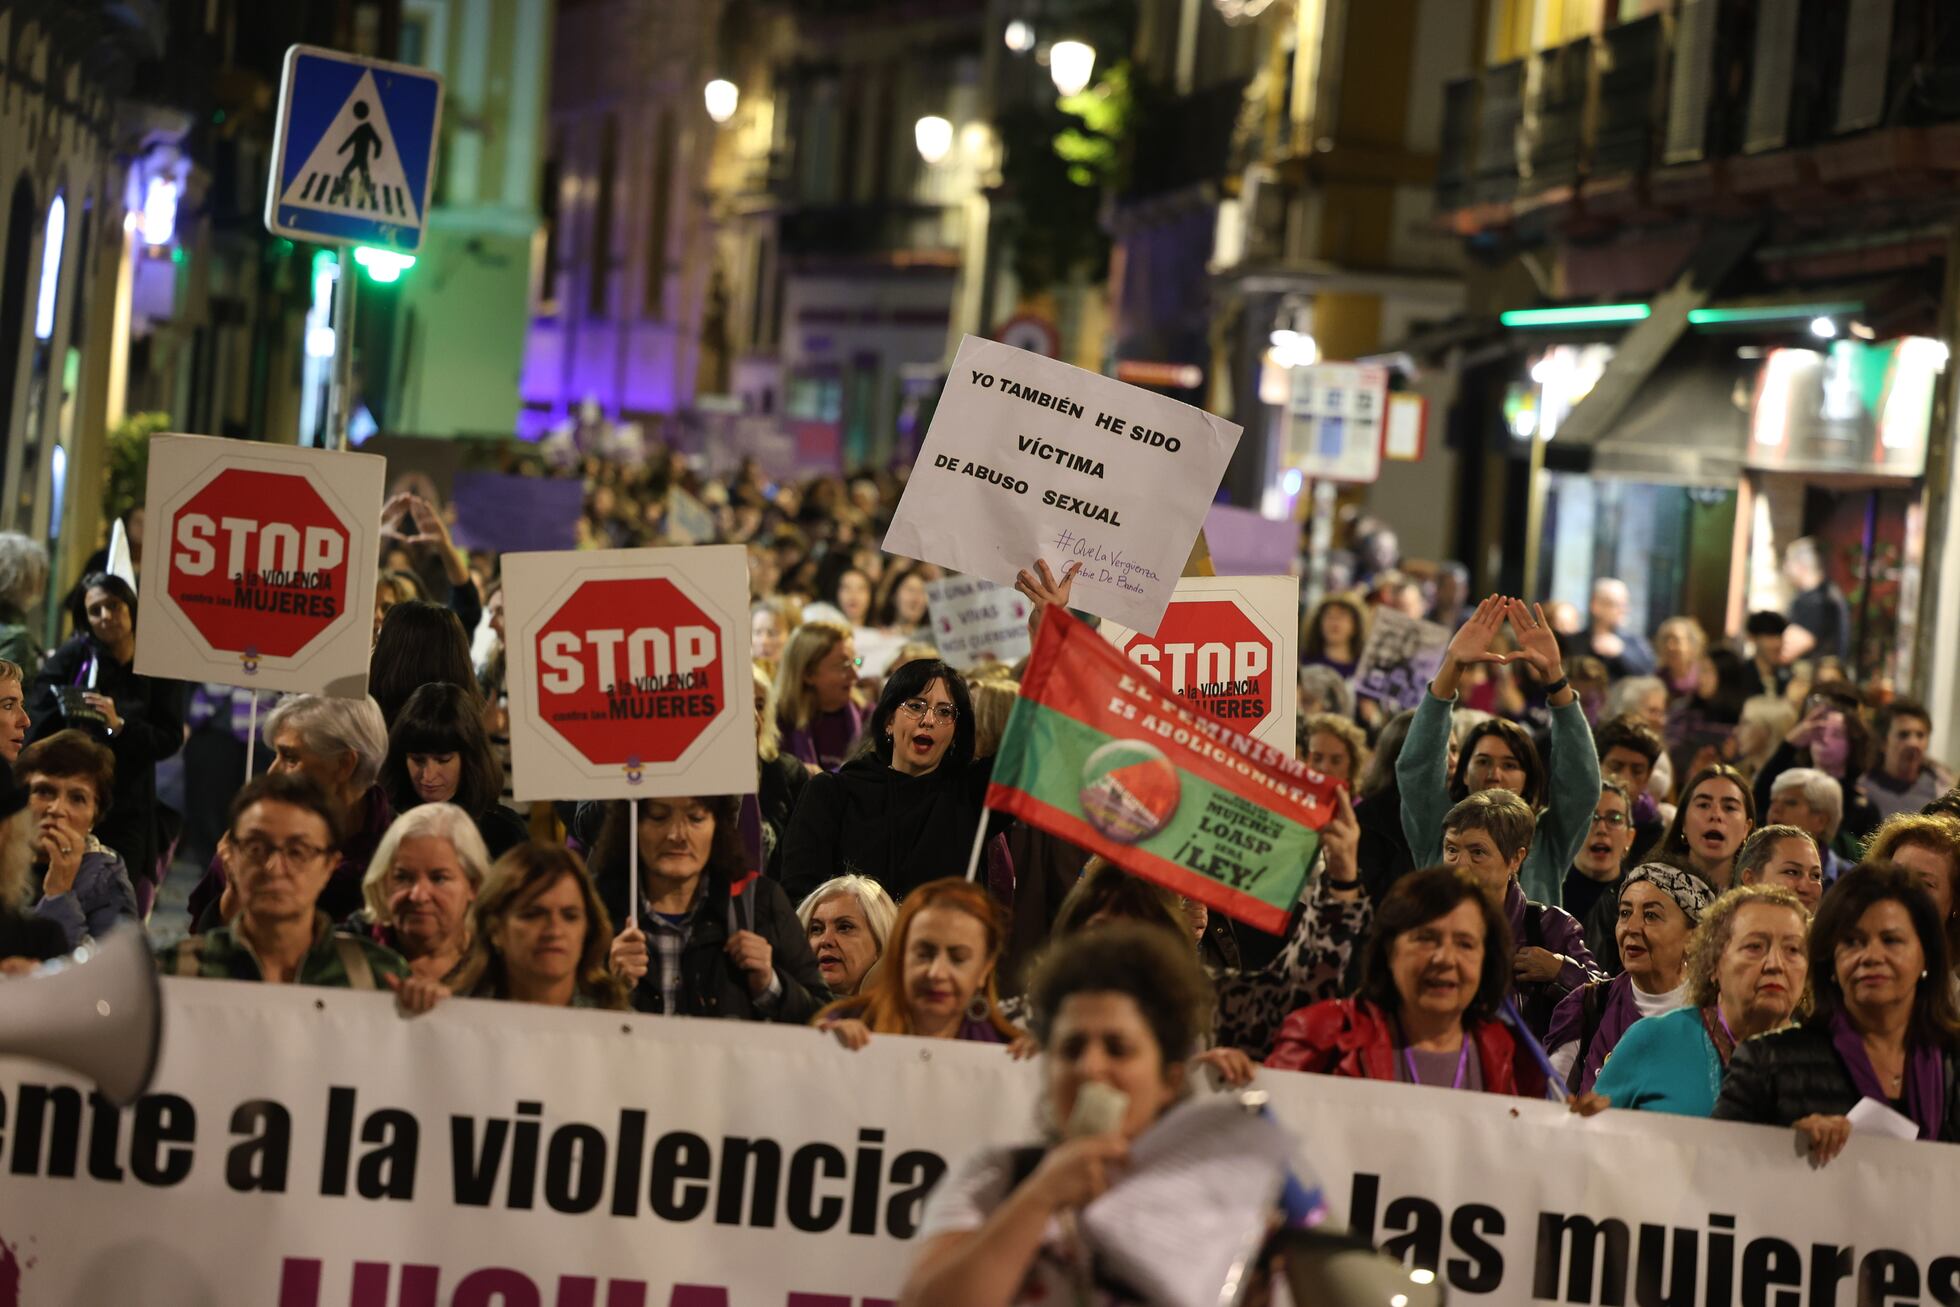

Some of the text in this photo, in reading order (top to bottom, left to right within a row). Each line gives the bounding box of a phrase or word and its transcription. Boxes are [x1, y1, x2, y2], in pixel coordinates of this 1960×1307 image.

[970, 370, 1182, 453] YO TAMBIÉN HE SIDO
[1017, 435, 1106, 479] VÍCTIMA
[934, 454, 1121, 527] DE ABUSO SEXUAL
[174, 512, 345, 580] STOP
[234, 569, 332, 590] a la VIOLENCIA
[1060, 559, 1095, 580] Cbie
[234, 586, 337, 618] MUJERES
[540, 625, 717, 694] STOP
[1128, 641, 1268, 695] STOP
[606, 671, 709, 698] a la VIOLENCIA
[1118, 674, 1153, 701] EL
[1188, 684, 1197, 699] la
[1200, 679, 1260, 698] VIOLENCIA
[609, 694, 717, 720] MUJERES
[1191, 699, 1265, 719] JERES
[1108, 696, 1138, 720] ES
[1141, 715, 1318, 810] ABOLICIONISTA
[1199, 815, 1272, 856] LOASP
[1206, 801, 1281, 839] MUJERES
[1173, 833, 1269, 891] ¡LEY!
[0, 1082, 196, 1187] nte
[225, 1098, 291, 1193] a
[319, 1085, 420, 1201] la
[450, 1100, 948, 1240] violencia
[1348, 1172, 1506, 1294] las
